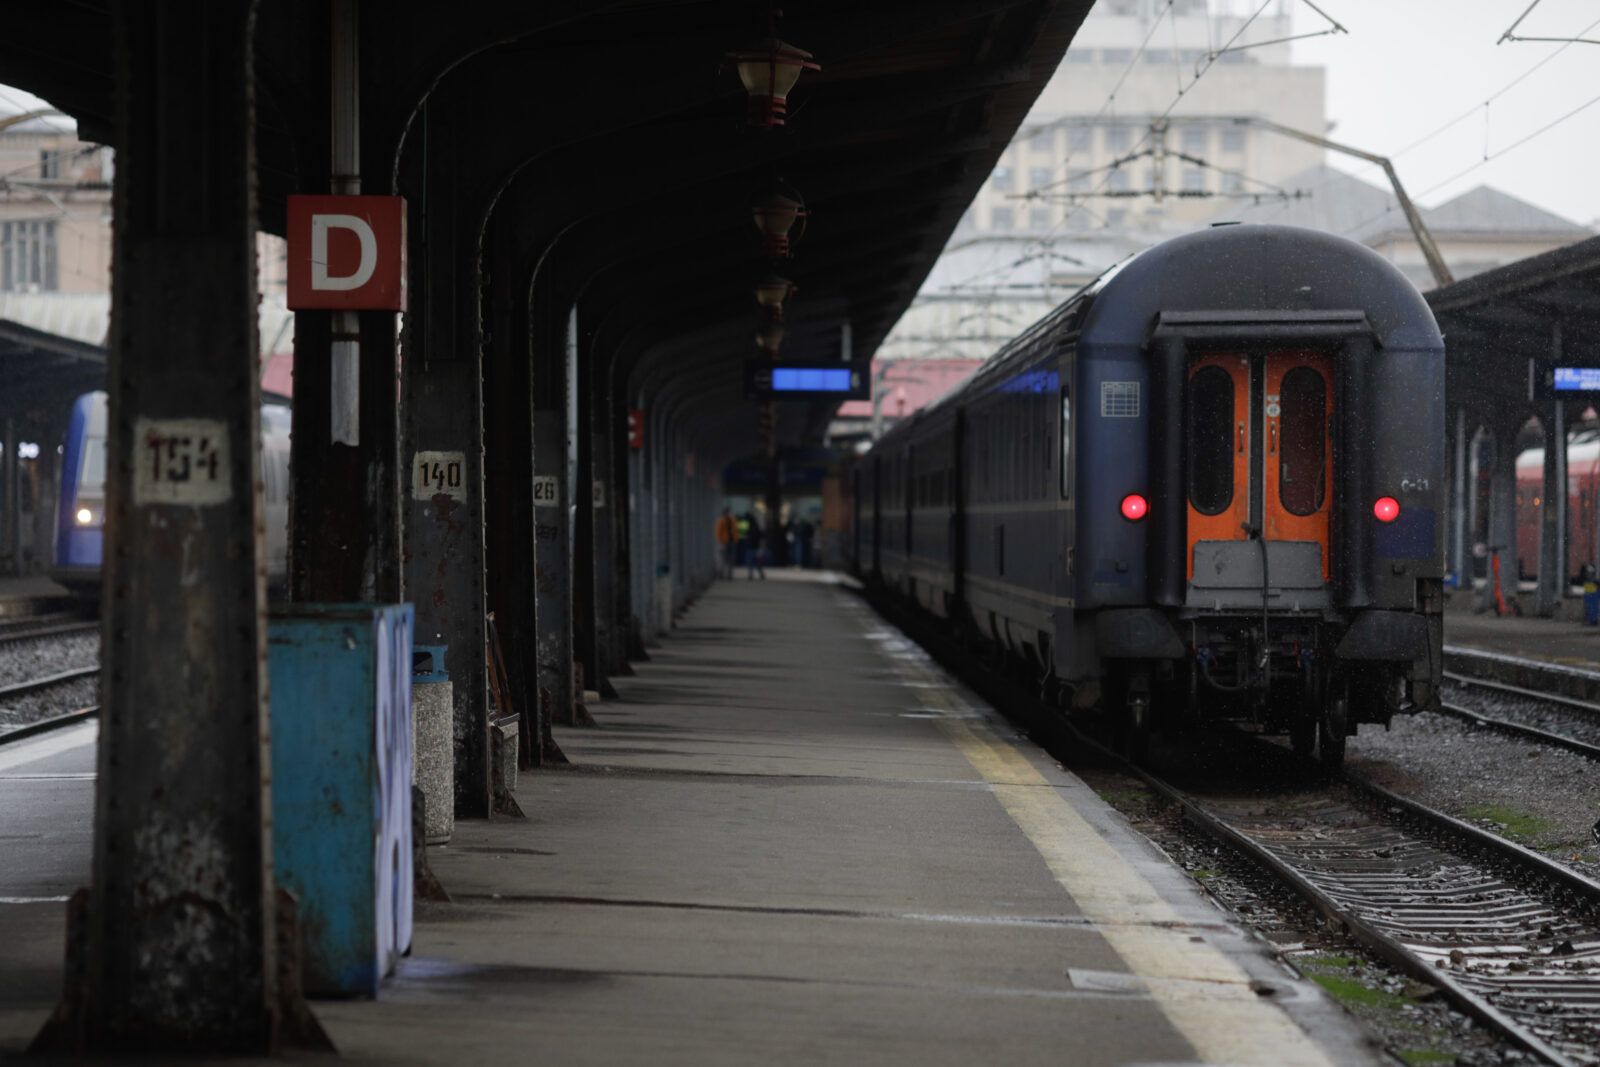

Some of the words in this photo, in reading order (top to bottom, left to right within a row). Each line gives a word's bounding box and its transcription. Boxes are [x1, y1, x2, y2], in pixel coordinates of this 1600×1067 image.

[311, 213, 379, 291] D
[146, 429, 220, 482] 154
[420, 462, 461, 488] 140
